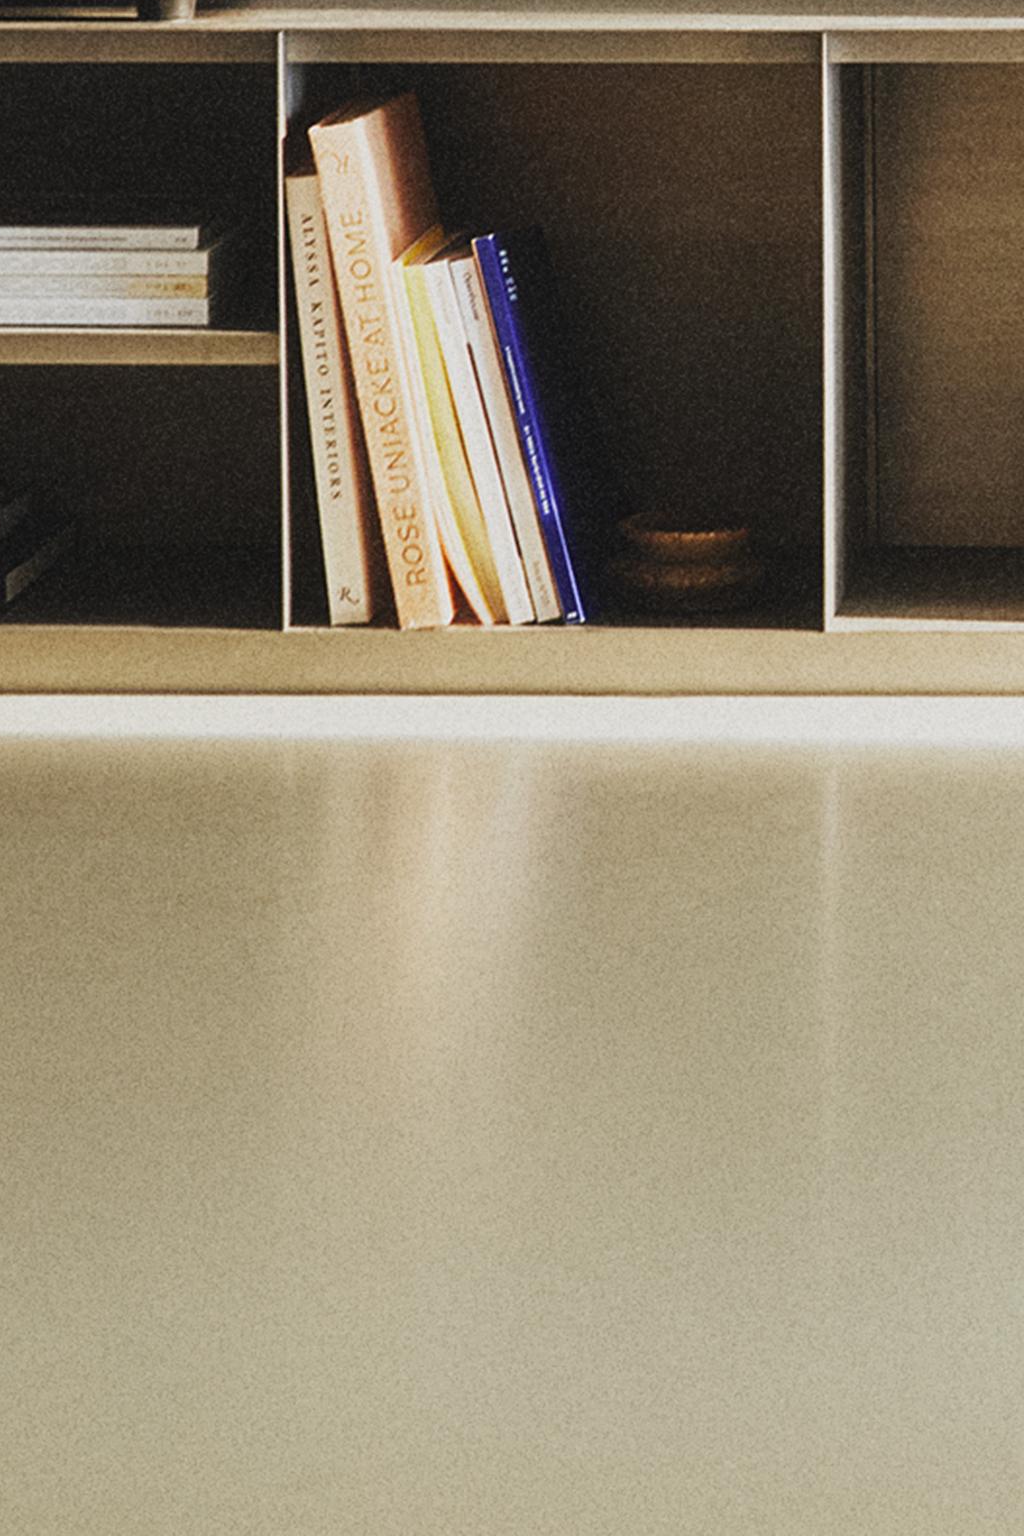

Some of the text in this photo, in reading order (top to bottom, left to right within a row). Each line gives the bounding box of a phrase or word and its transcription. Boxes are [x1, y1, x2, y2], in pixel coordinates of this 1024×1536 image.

[301, 213, 342, 500] ALYSSA KAPITO INTERIORS
[340, 208, 426, 588] ROSE UNIACKE AT HOME
